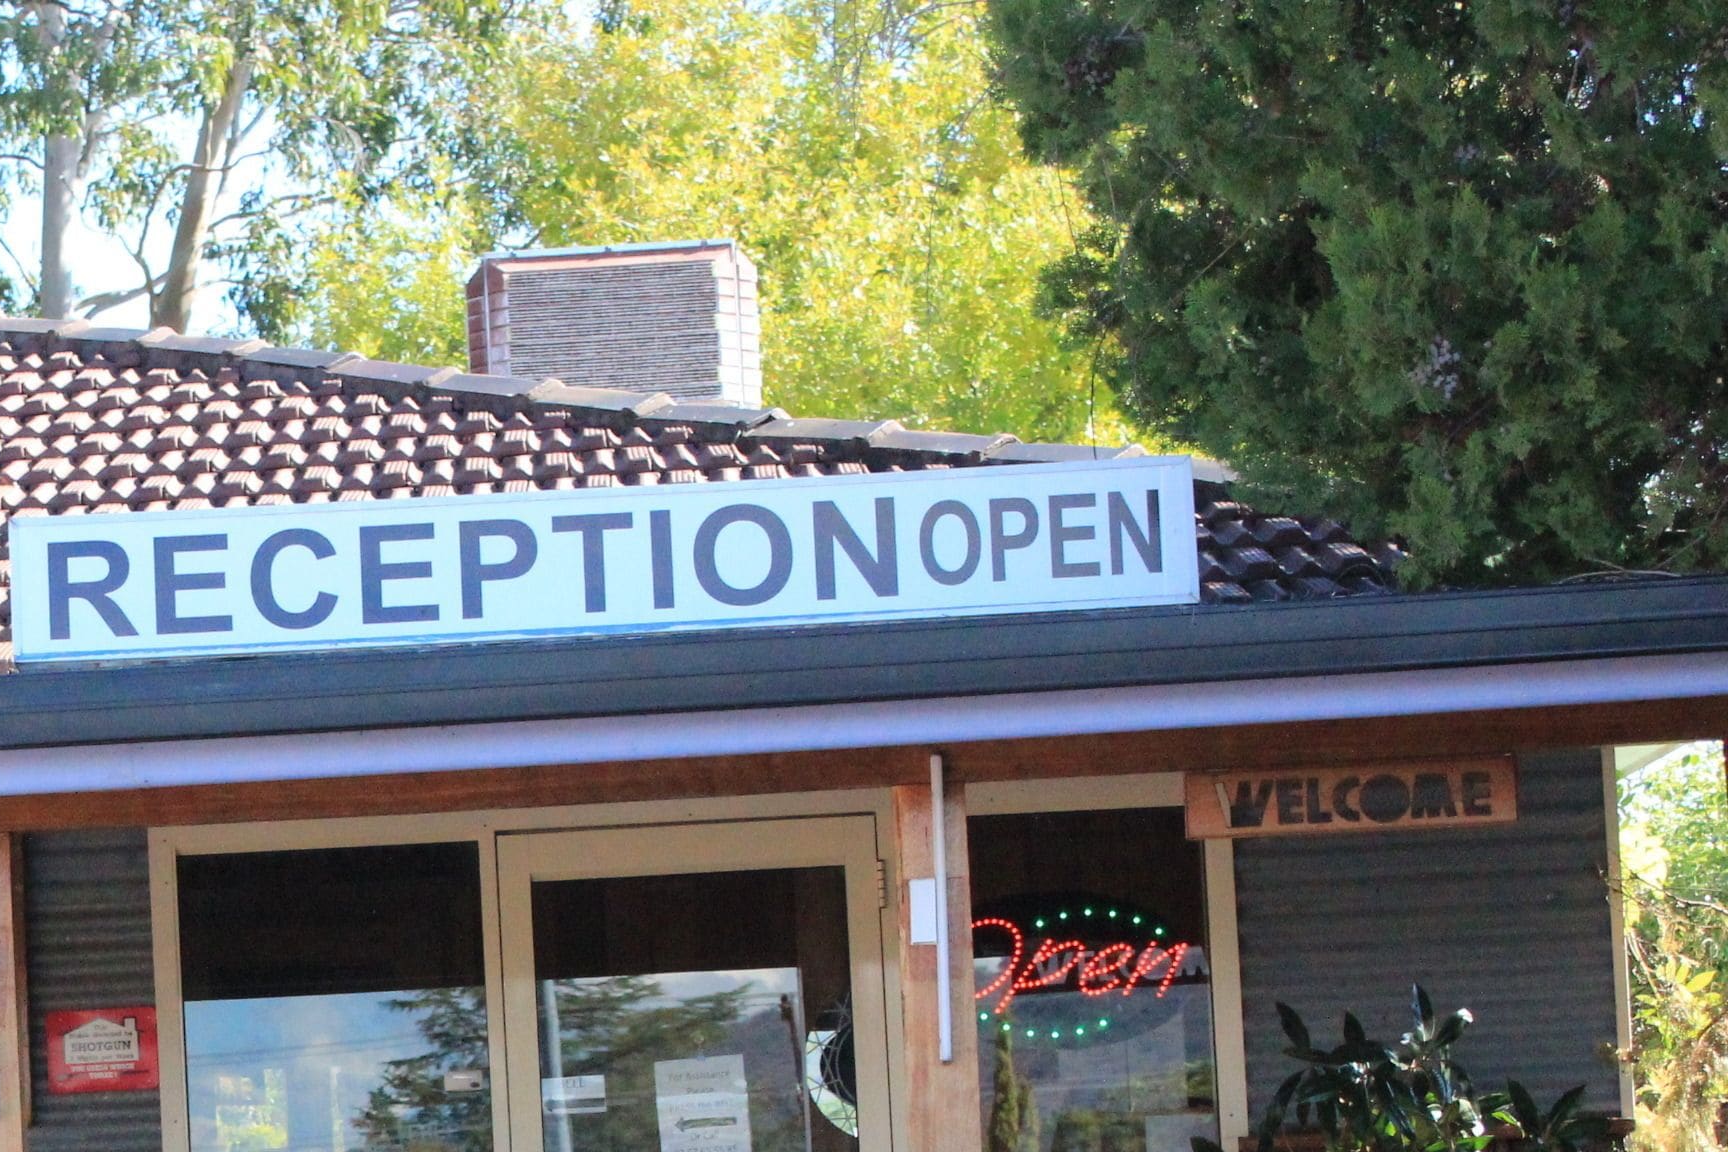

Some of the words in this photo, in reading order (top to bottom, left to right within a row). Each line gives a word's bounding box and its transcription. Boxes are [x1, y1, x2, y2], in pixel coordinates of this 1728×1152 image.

[44, 496, 900, 642] RECEPTION
[918, 487, 1163, 587] OPEN
[1215, 771, 1493, 829] WELCOME
[71, 1040, 132, 1053] SHOTGUN
